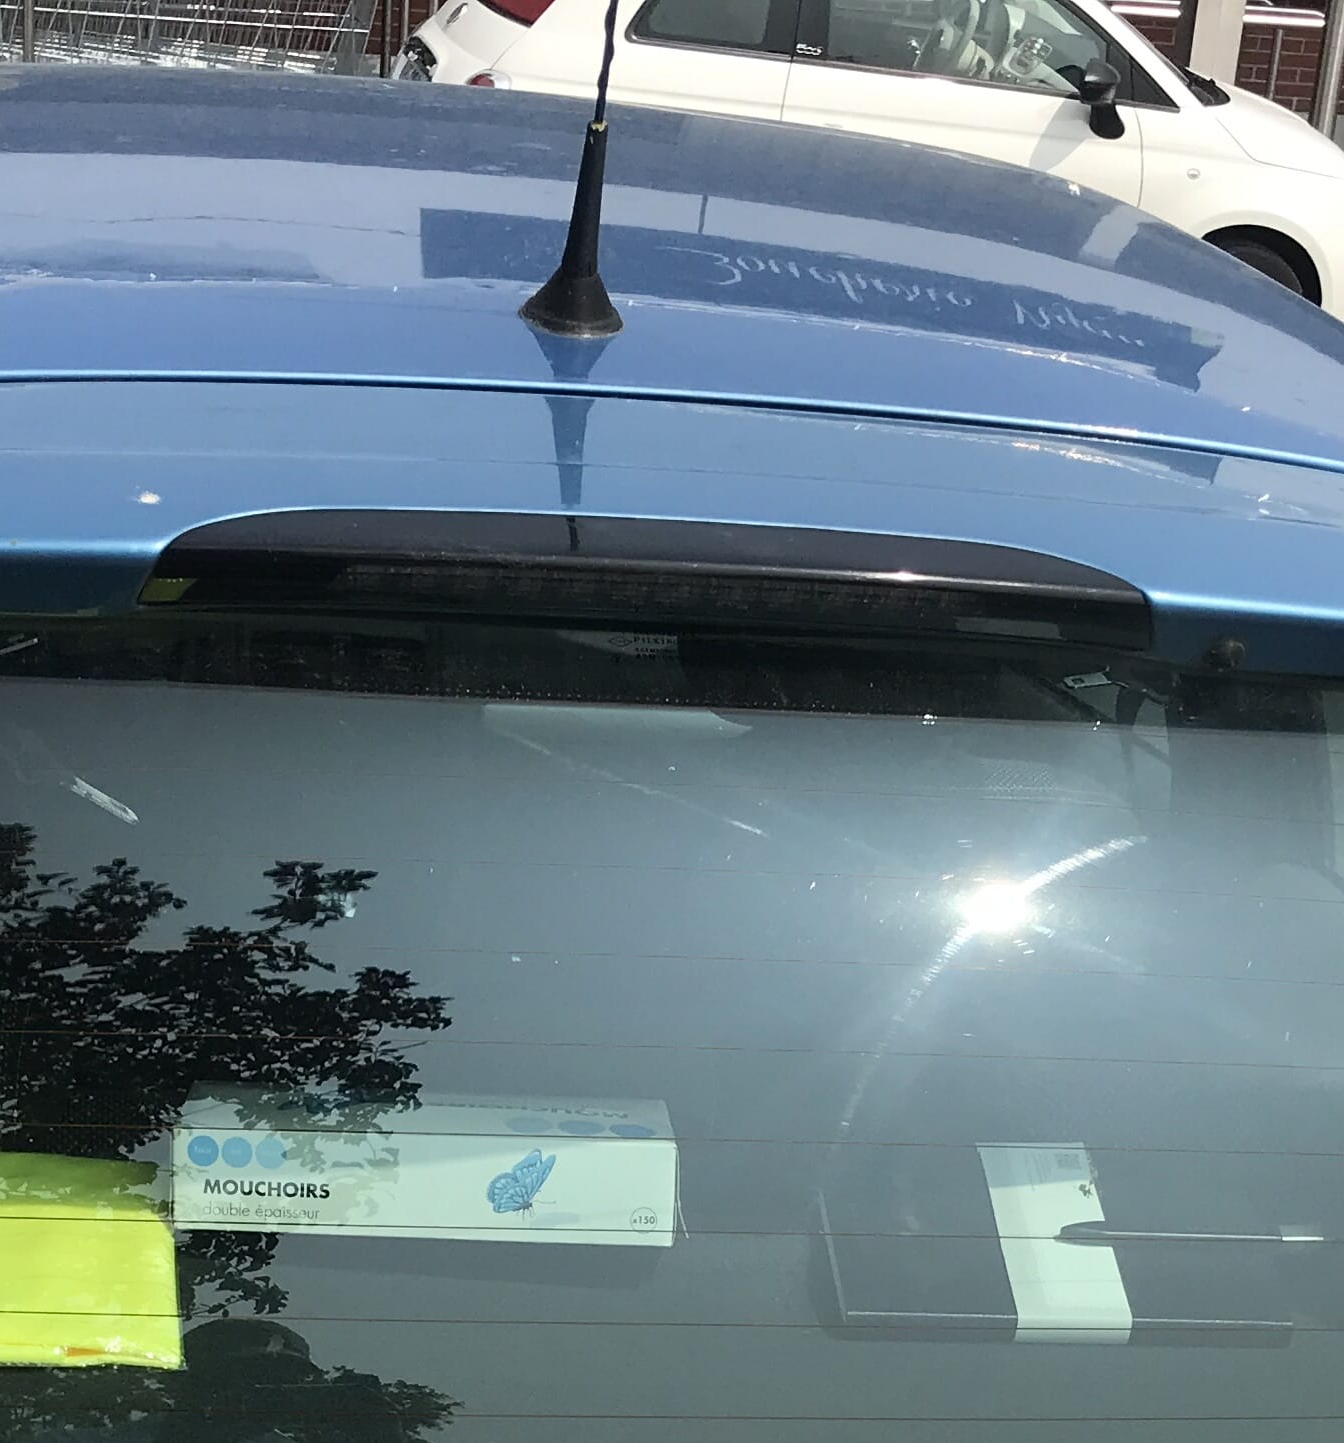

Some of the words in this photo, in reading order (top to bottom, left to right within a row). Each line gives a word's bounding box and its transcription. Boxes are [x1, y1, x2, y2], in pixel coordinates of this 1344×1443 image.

[203, 1178, 330, 1199] MOUCHOIRS
[203, 1201, 250, 1217] double
[255, 1204, 320, 1221] épaisseur
[632, 1215, 656, 1225] x150
